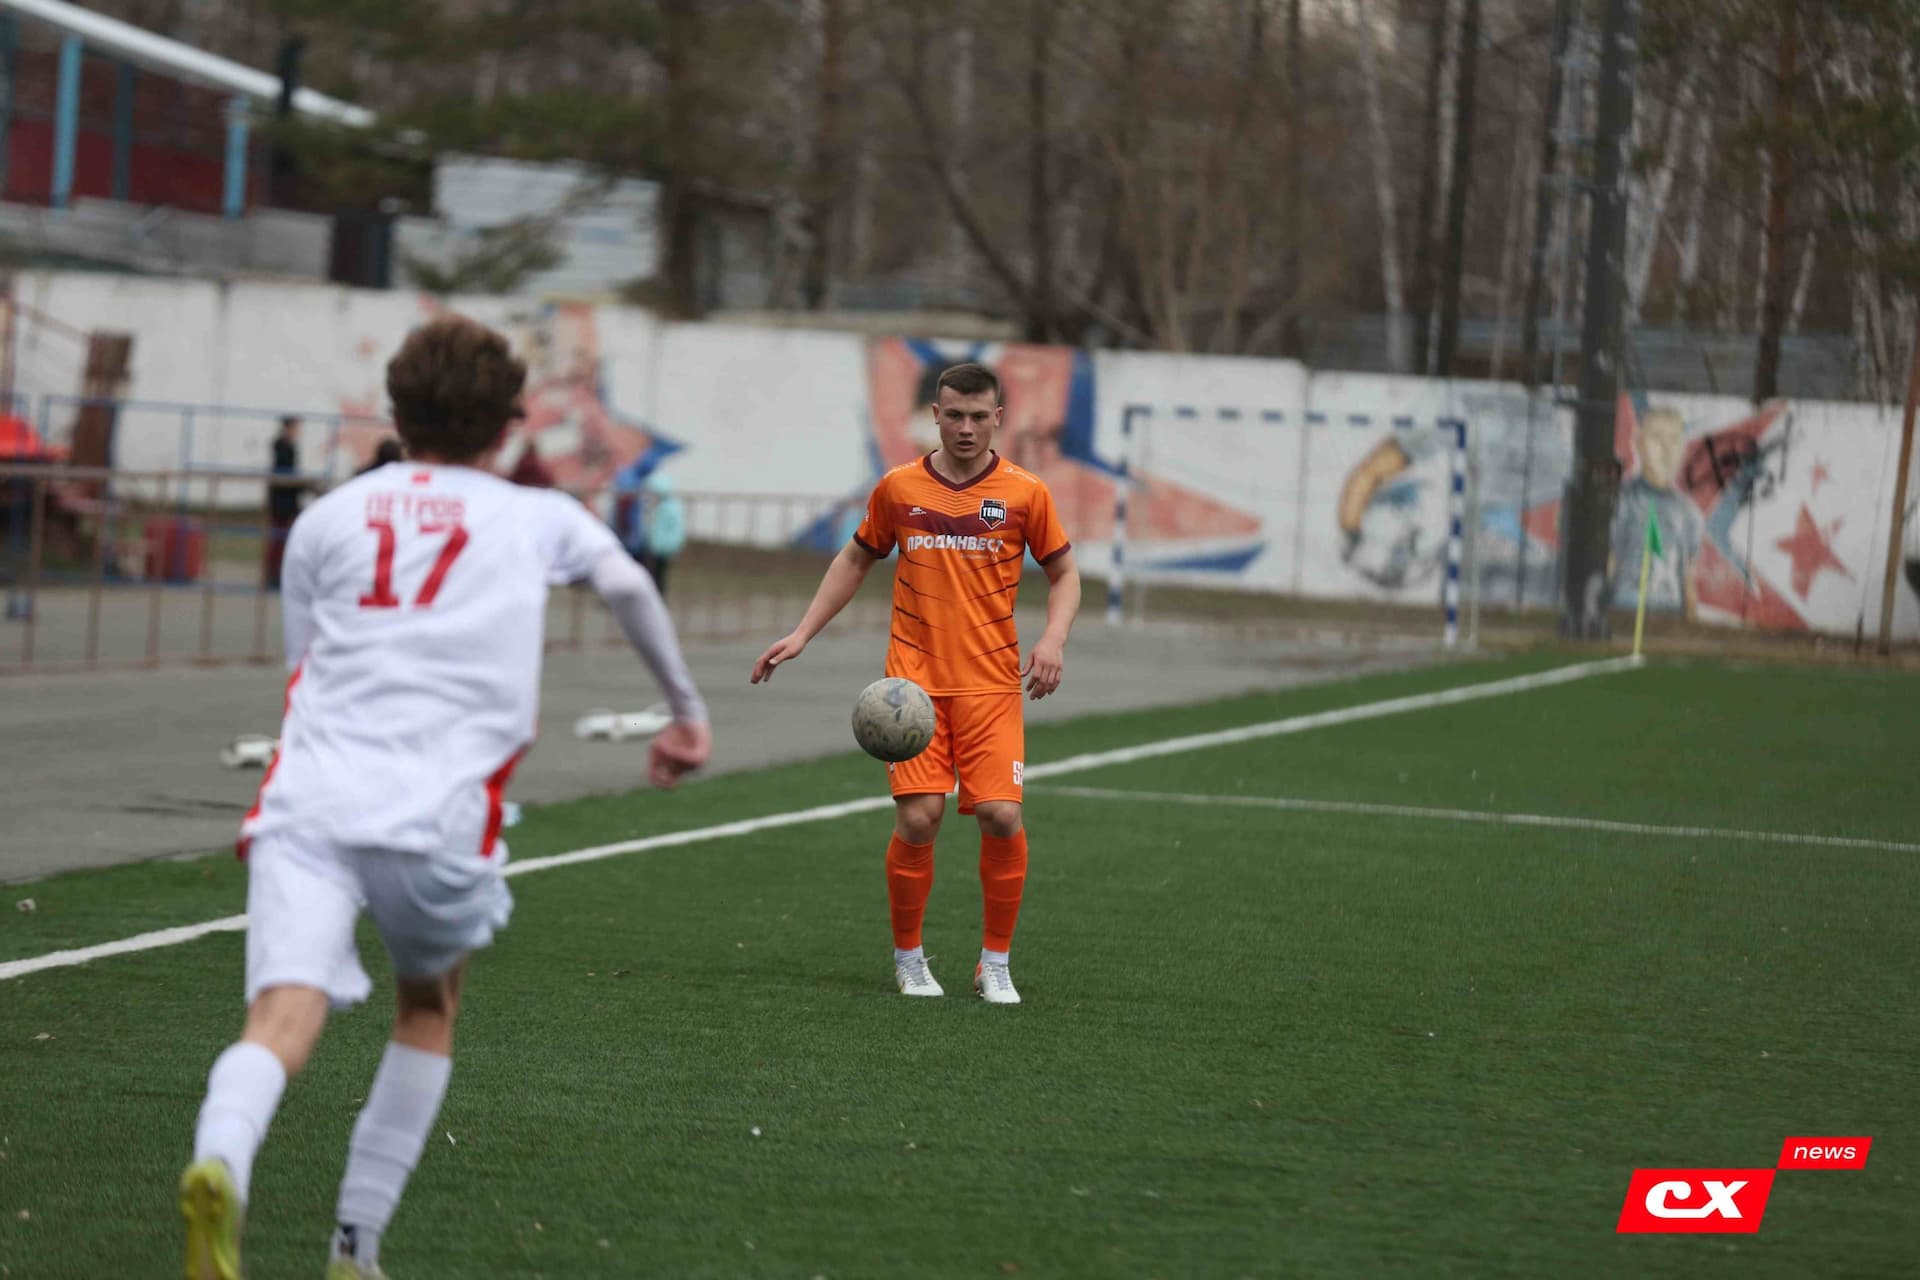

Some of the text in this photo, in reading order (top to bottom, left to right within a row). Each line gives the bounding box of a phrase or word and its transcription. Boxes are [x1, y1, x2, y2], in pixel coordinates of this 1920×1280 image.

[982, 507, 1005, 519] ТЕМП
[907, 535, 1004, 553] ПРОДИНВЕСТ
[358, 522, 469, 607] 17
